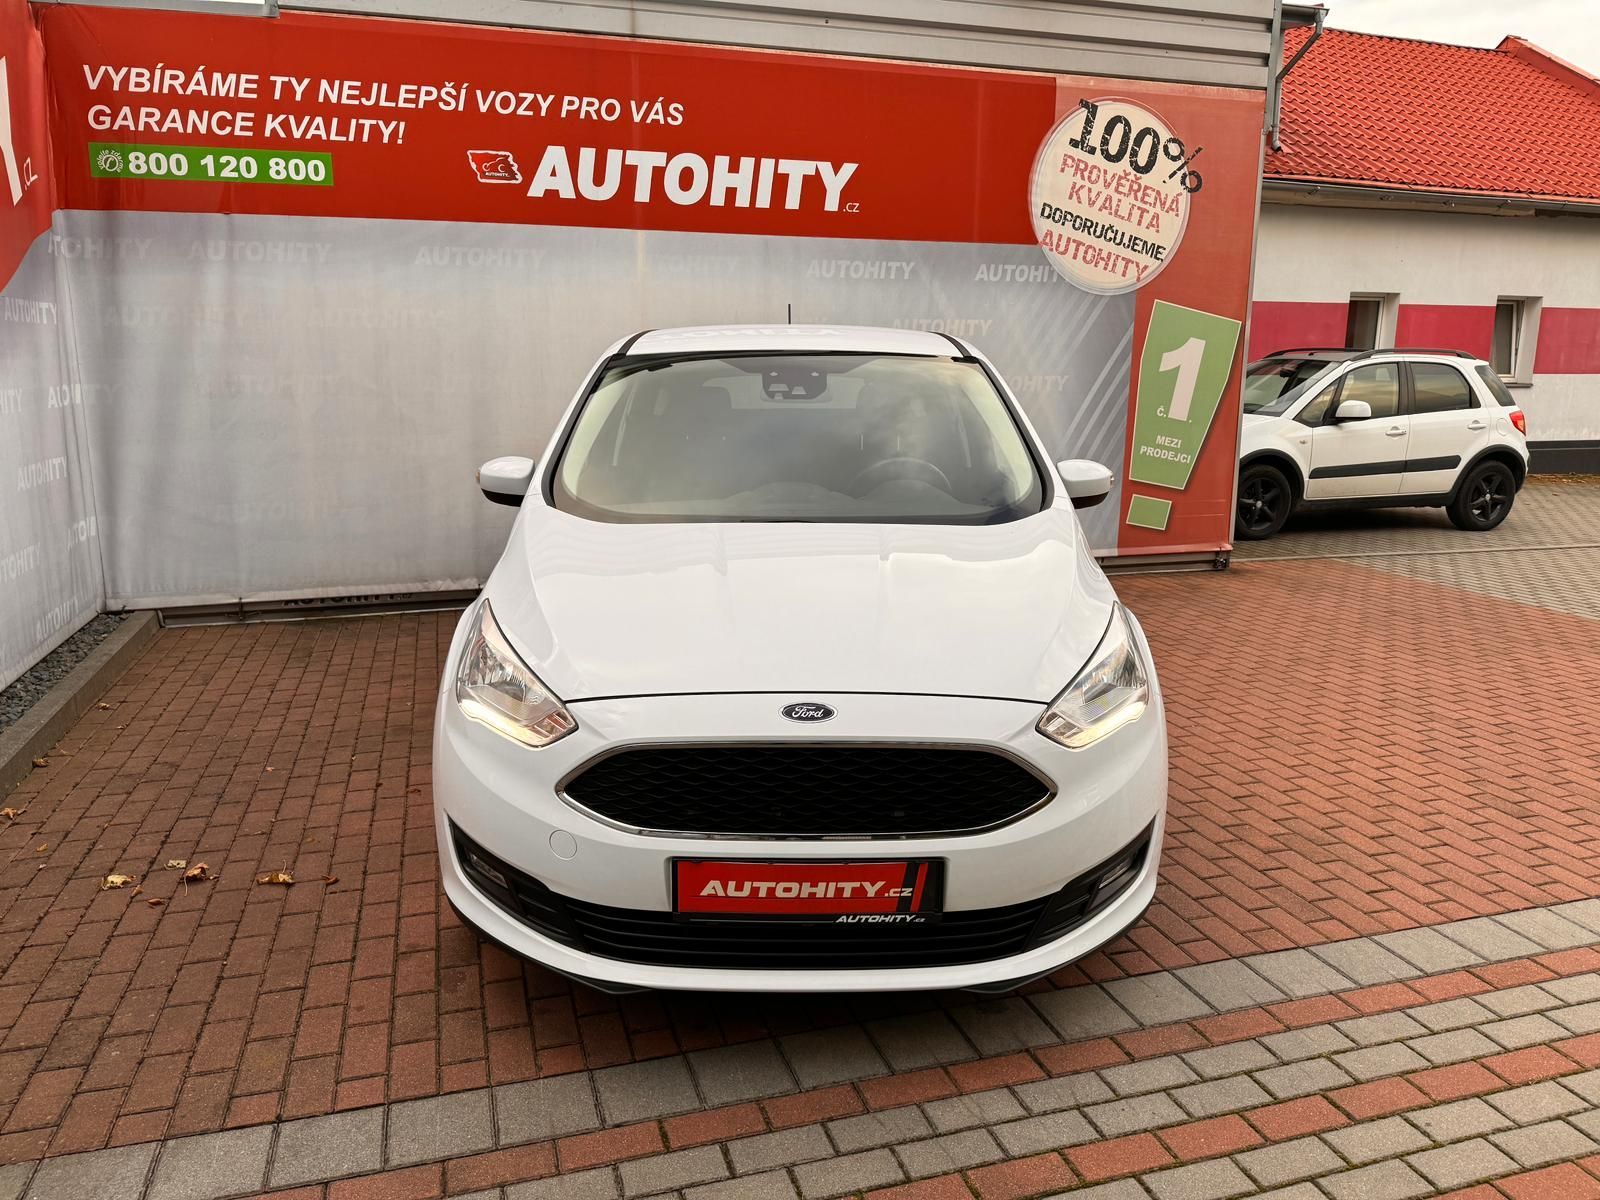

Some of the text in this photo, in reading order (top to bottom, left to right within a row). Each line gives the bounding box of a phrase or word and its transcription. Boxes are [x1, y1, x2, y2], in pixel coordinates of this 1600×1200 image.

[83, 63, 684, 125] VYBÍRÁME TY NEJLEPŠÍ VOZY PRO VÁS
[87, 104, 406, 144] GARANCE KVALITY!
[1069, 98, 1203, 194] 100%
[128, 151, 326, 182] 800 120 800
[1059, 153, 1183, 217] PROVĚŘENÁ
[1068, 182, 1160, 233] KVALITA
[1040, 202, 1166, 262] DOPORUČUJEME
[806, 259, 915, 280] AUTOHITY
[1039, 229, 1150, 282] AUTOHITY
[1140, 445, 1192, 463] PRODEJCI
[1156, 434, 1182, 448] MEZI
[792, 705, 824, 718] Ford
